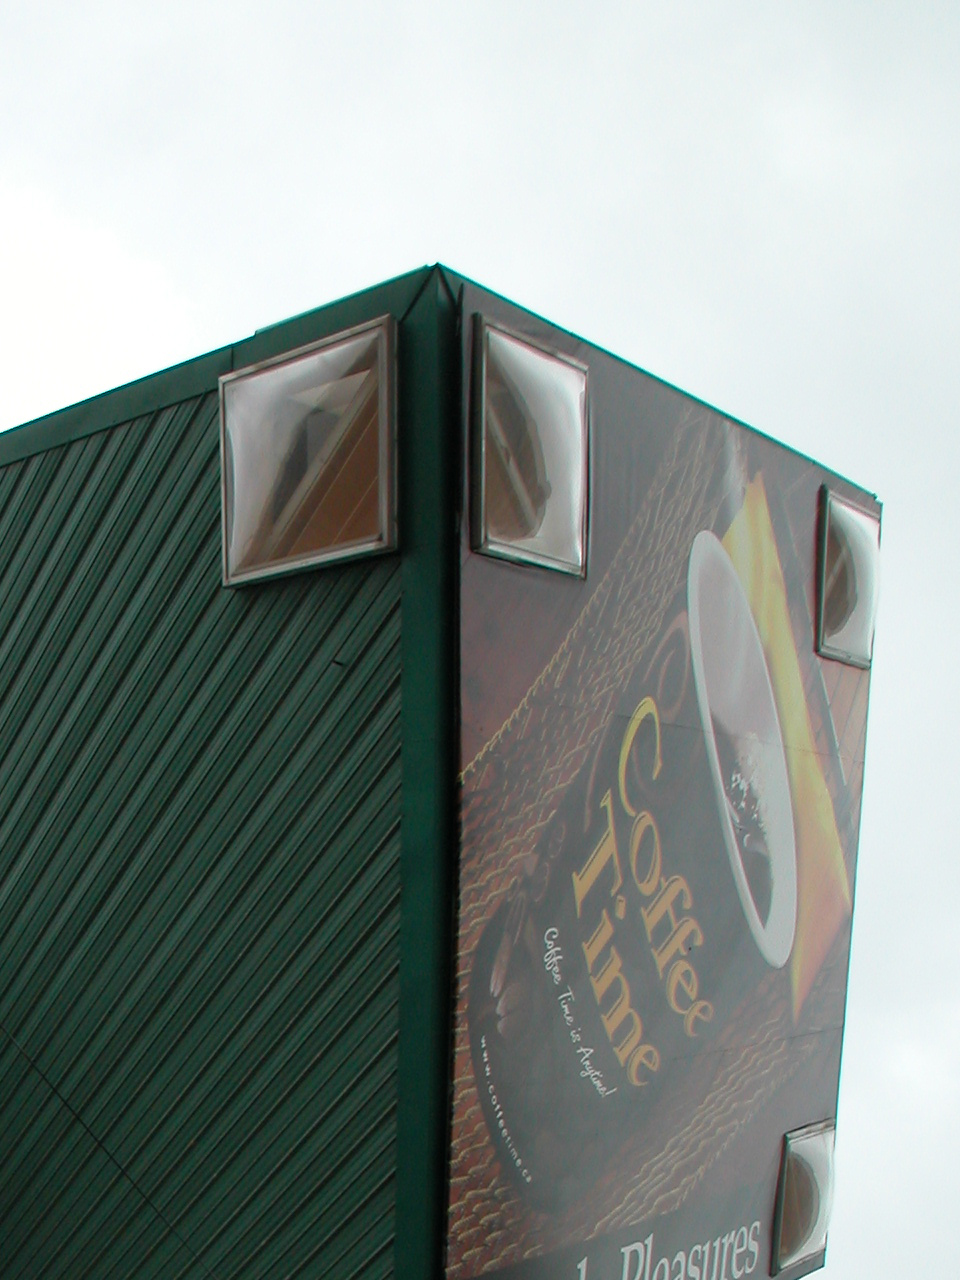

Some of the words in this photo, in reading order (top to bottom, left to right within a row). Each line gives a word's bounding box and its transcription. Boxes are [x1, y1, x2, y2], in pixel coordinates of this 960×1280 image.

[573, 788, 662, 1087] Time
[618, 696, 714, 1038] Coffee
[480, 1034, 532, 1184] www.coffeetime.ca
[542, 926, 563, 985] Coffee
[557, 985, 575, 1027] Time
[569, 1027, 582, 1044] is
[576, 1045, 618, 1098] Anytime!
